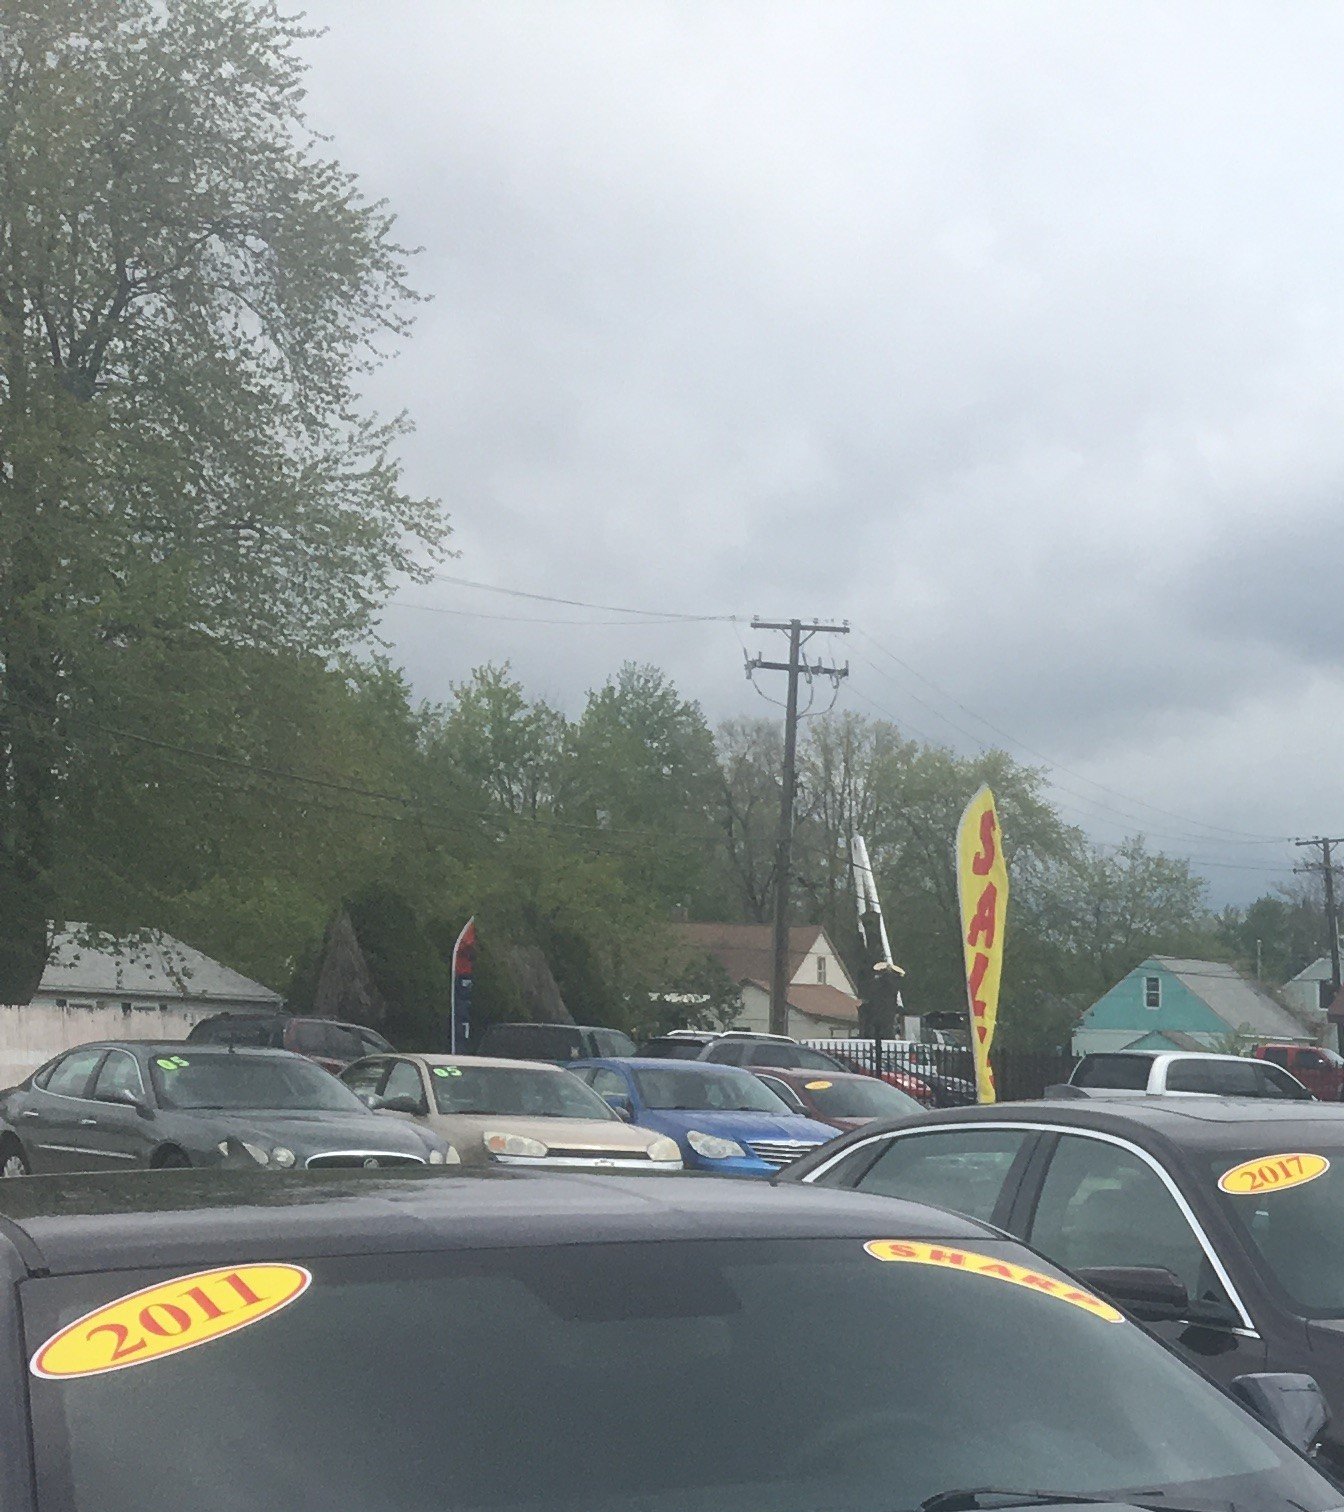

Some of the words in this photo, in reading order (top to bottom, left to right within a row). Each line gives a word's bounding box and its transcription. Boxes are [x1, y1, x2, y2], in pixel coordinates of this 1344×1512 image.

[1240, 1156, 1304, 1191] 2017
[888, 1244, 1103, 1307] SHARP
[86, 1272, 271, 1362] 2011
